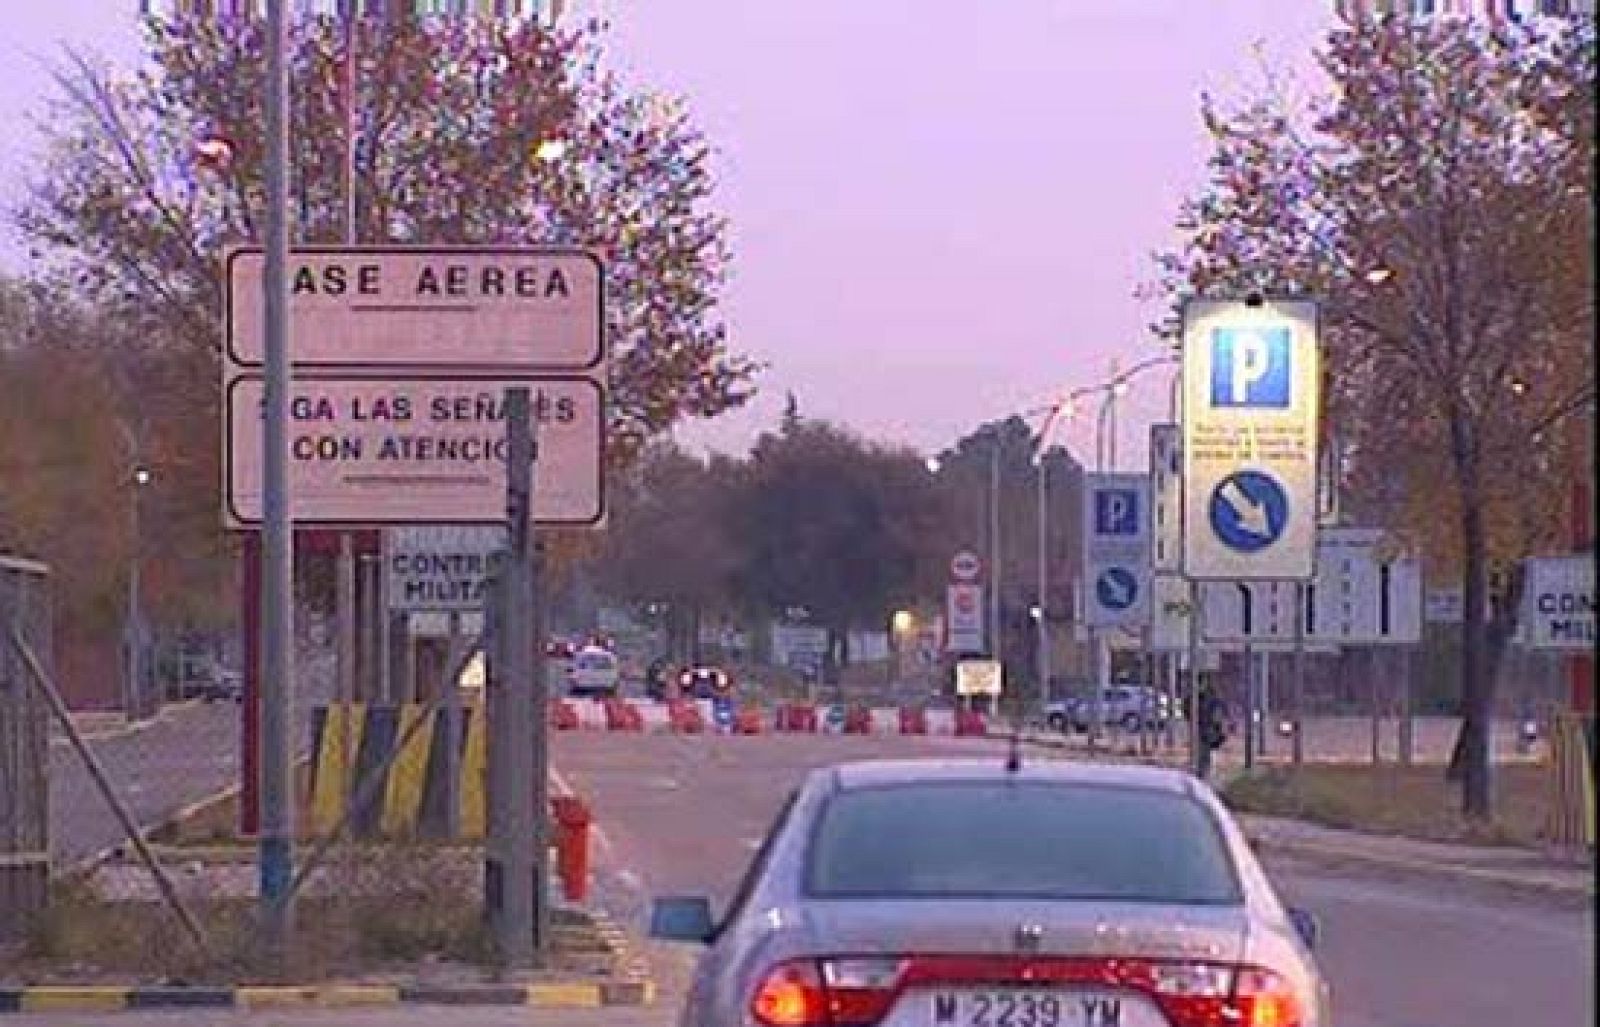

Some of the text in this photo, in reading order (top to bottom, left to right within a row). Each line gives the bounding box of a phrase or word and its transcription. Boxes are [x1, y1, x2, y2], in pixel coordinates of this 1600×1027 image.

[292, 264, 570, 298] ASE AEREA
[1231, 329, 1270, 403] P
[351, 396, 412, 421] LAS
[430, 391, 576, 423] SEÑES
[293, 436, 362, 461] CON
[392, 552, 486, 575] CONTR
[935, 993, 957, 1022] M
[971, 993, 1061, 1027] 2239
